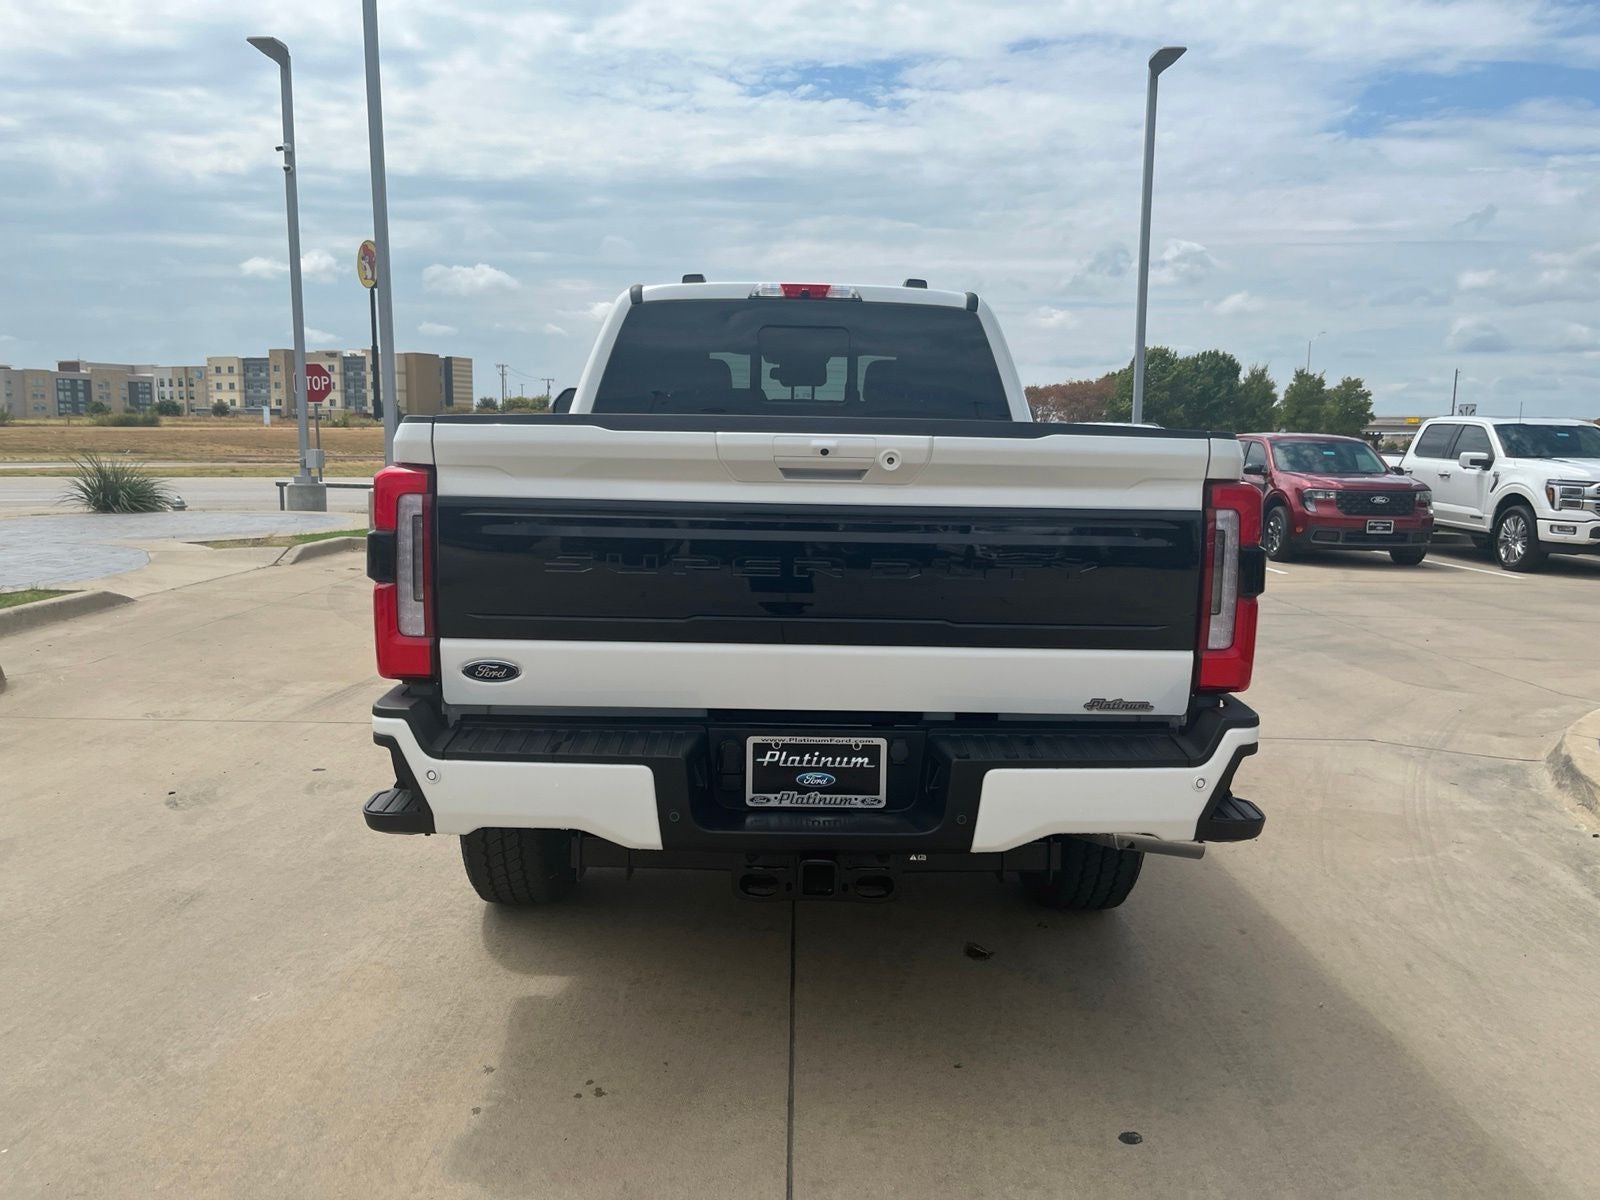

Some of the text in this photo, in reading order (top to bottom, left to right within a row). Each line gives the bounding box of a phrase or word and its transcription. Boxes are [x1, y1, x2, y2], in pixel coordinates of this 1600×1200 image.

[306, 375, 330, 391] TOP
[475, 664, 508, 678] Ford
[1083, 698, 1154, 711] Platinum
[756, 750, 876, 768] Platinum
[803, 774, 829, 785] Ford
[778, 791, 858, 805] Platinum
